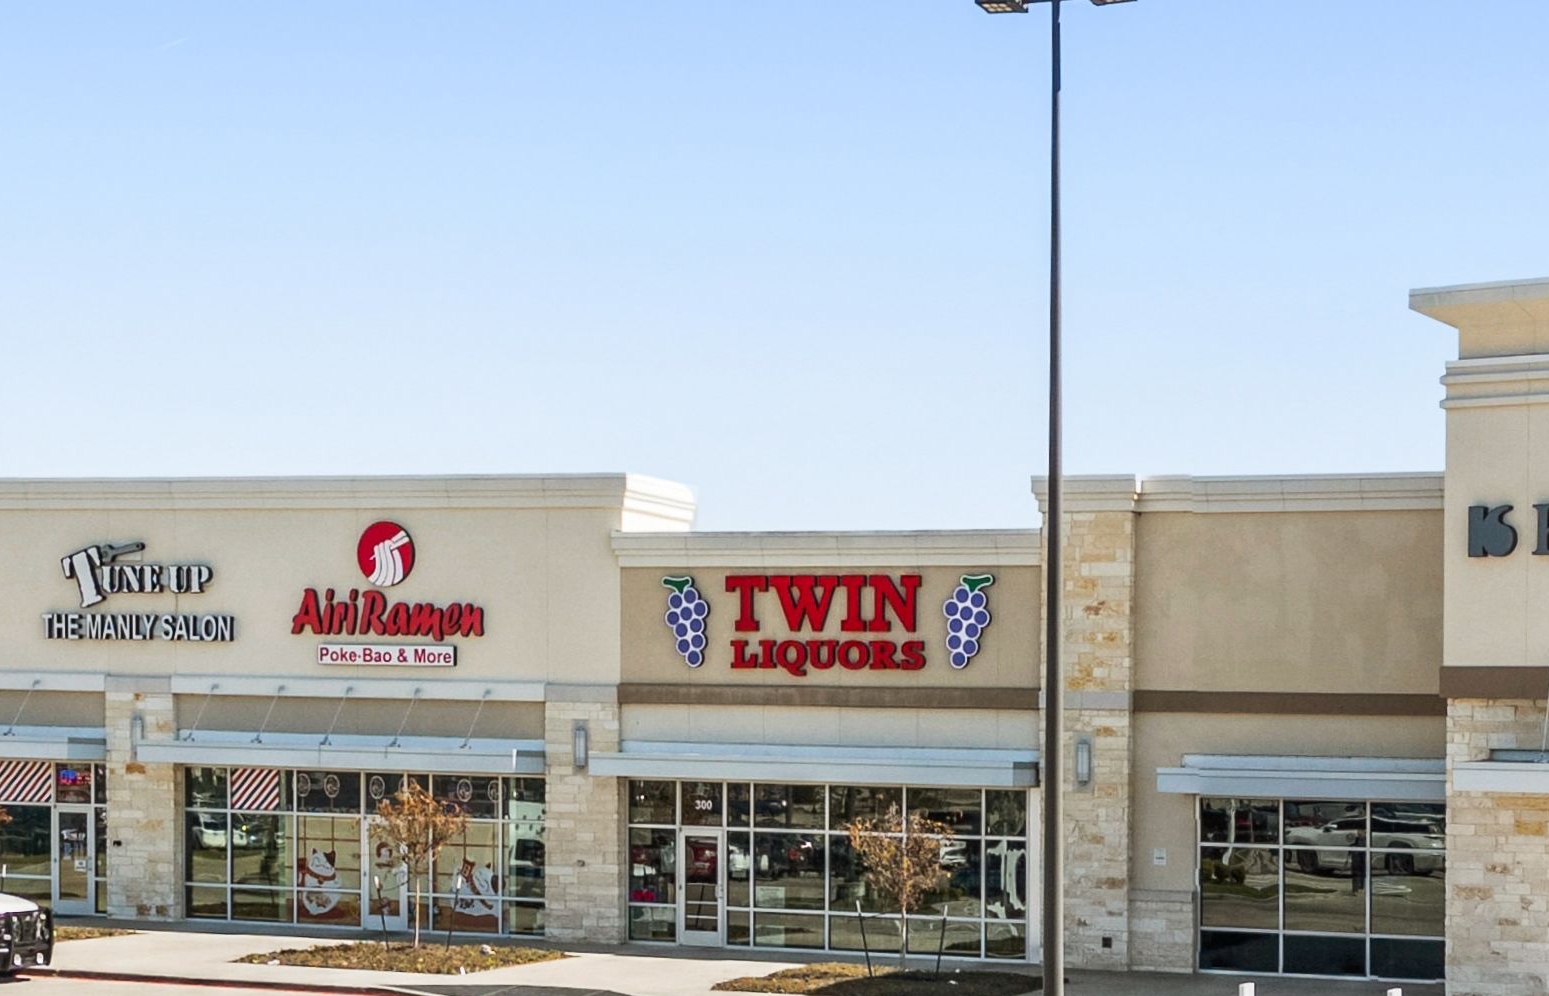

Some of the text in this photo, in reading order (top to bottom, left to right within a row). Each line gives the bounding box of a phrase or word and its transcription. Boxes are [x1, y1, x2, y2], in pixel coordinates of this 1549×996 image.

[168, 564, 213, 594] UP
[725, 574, 923, 632] TWIN
[42, 613, 235, 642] THE MANLY SALON
[397, 648, 408, 663] &
[414, 648, 452, 664] More
[729, 639, 926, 676] LIQUORS
[694, 800, 713, 810] 300
